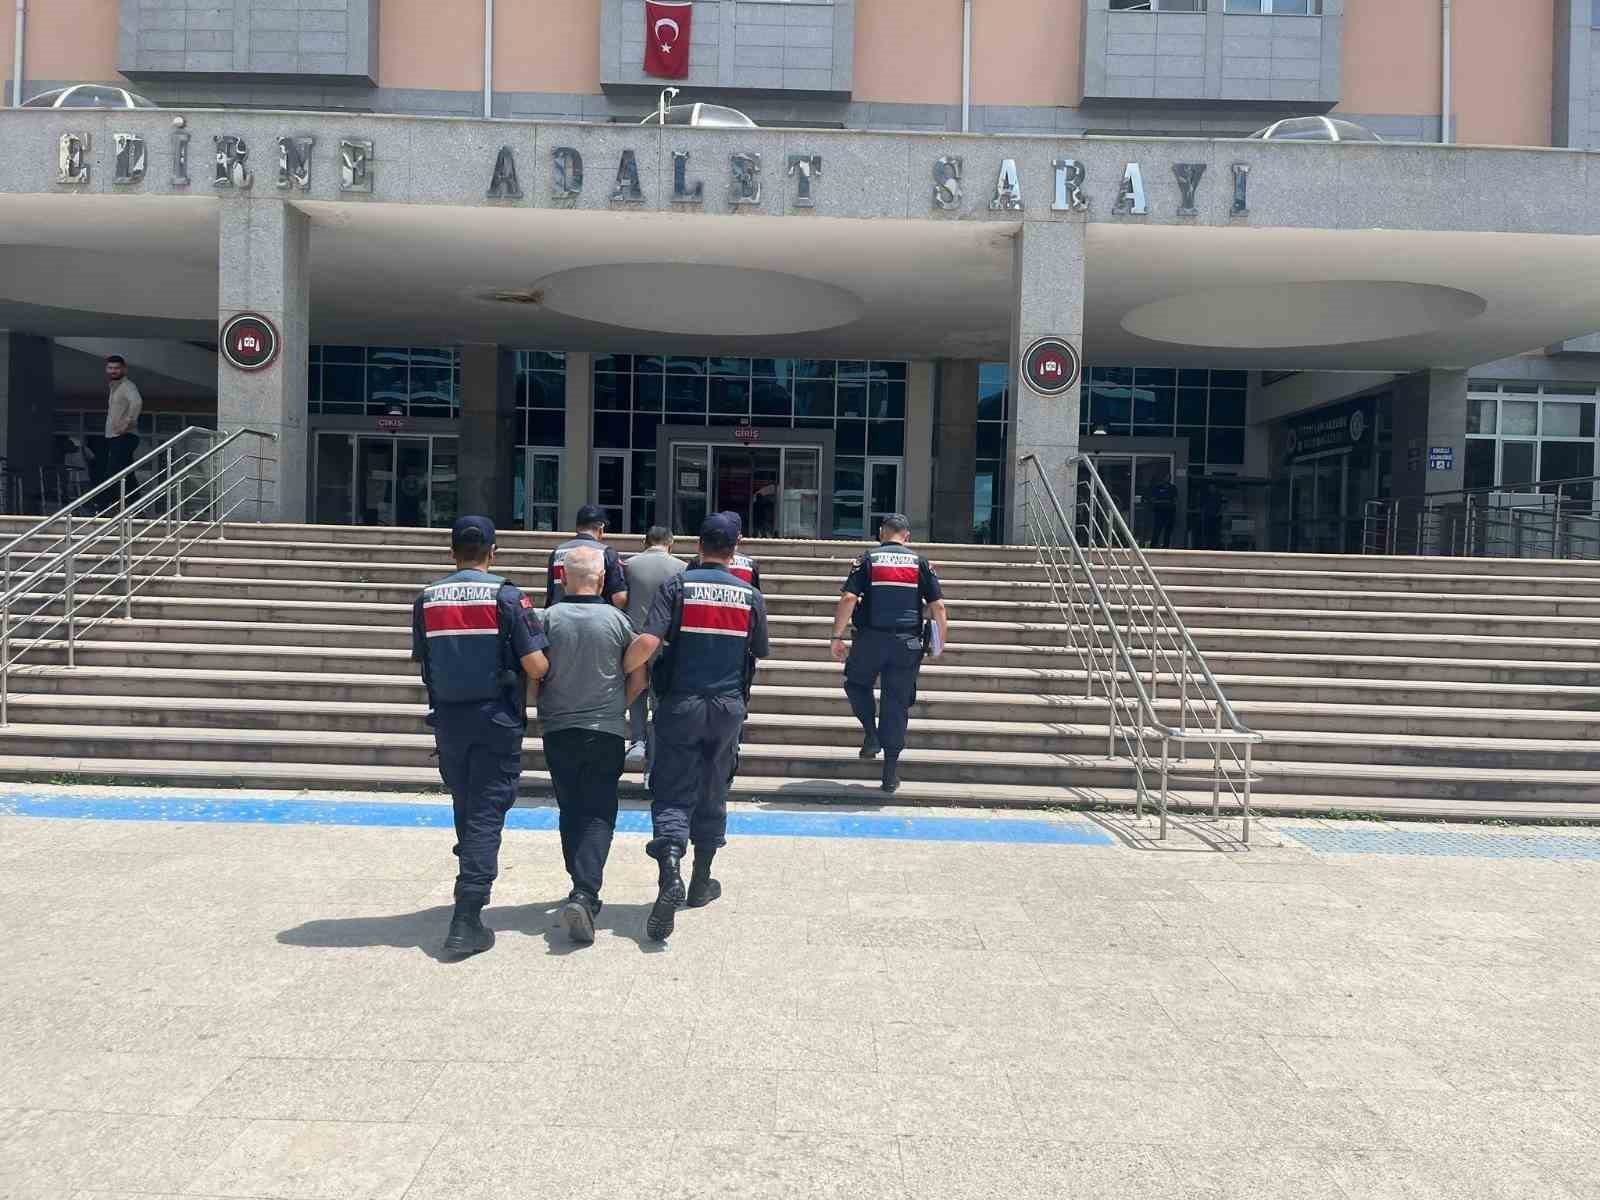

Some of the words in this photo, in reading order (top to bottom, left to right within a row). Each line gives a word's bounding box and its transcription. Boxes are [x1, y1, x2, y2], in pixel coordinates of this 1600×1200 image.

[56, 116, 374, 193] EDİRNE
[486, 145, 822, 208] ADALET
[932, 155, 1251, 217] SARAYI
[430, 586, 492, 601] JANDARMA
[691, 585, 746, 605] JANDARMA
